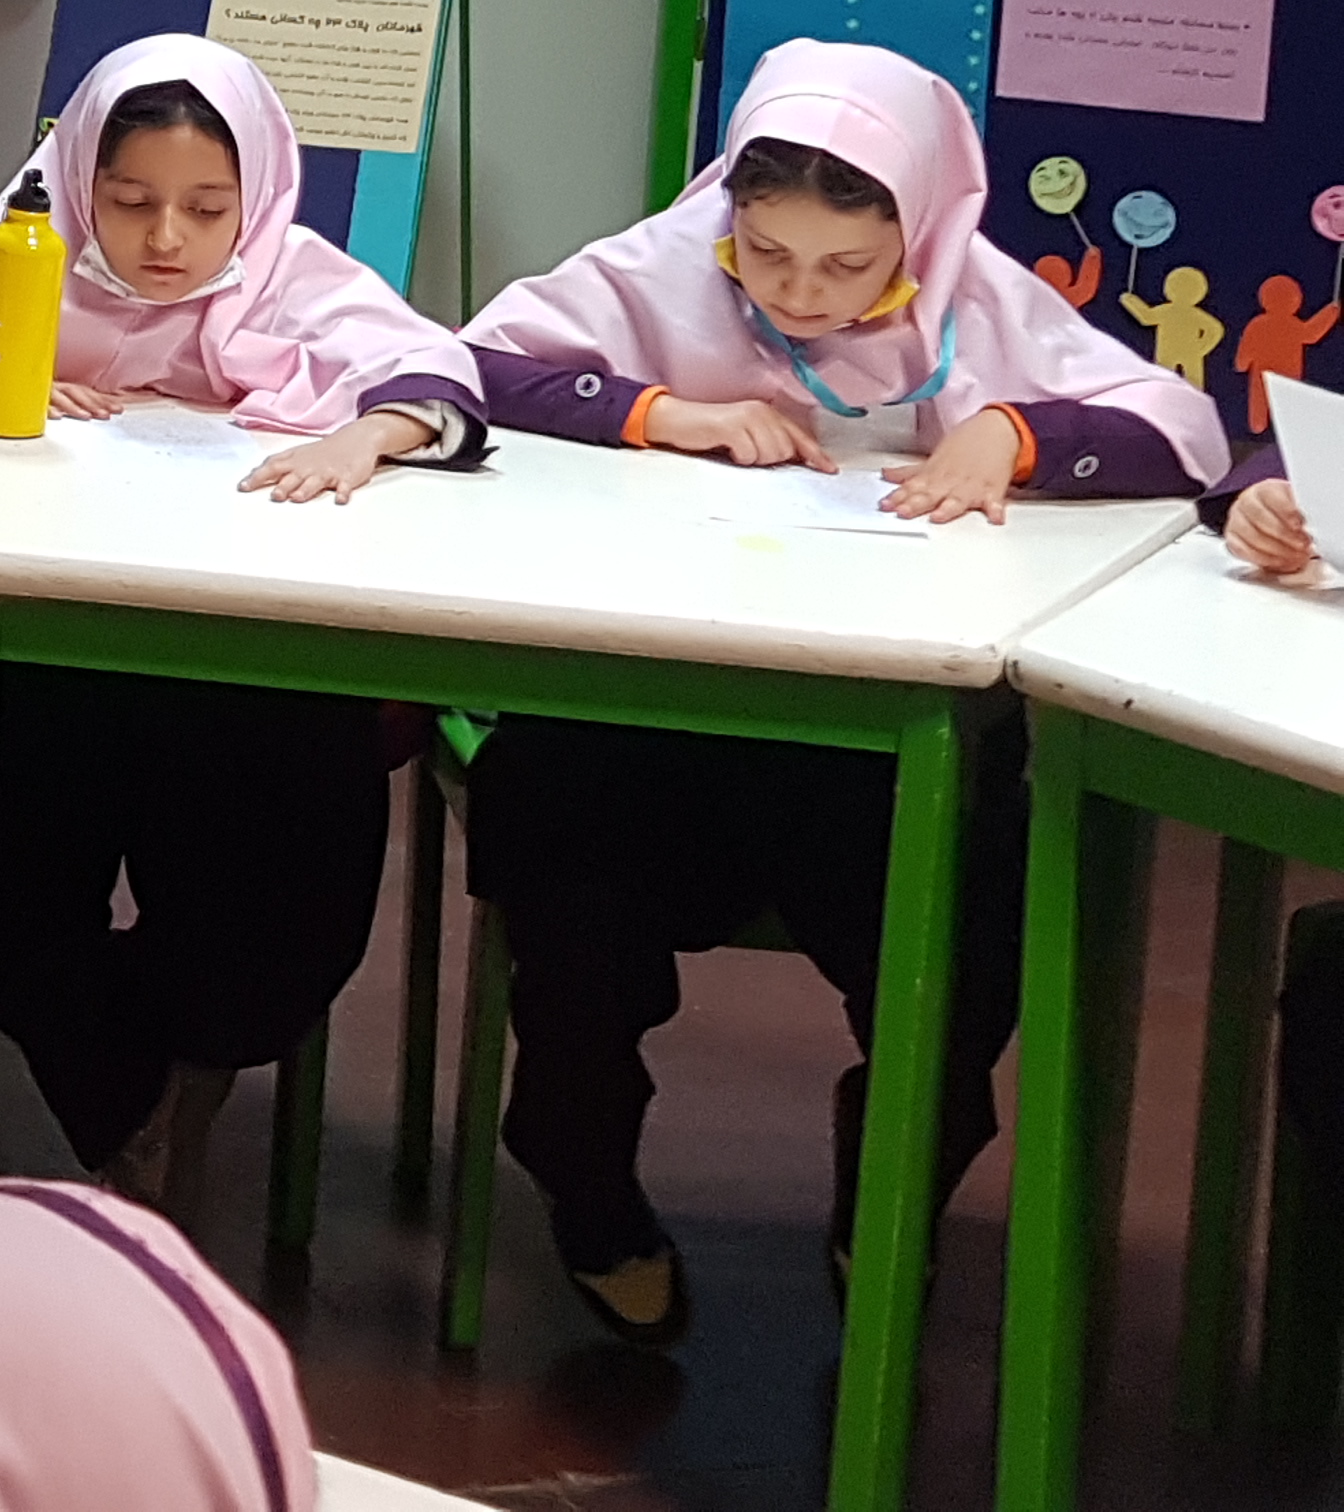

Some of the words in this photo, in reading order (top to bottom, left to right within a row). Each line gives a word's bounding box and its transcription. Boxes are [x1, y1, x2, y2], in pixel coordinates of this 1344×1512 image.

[233, 10, 267, 21] هستند
[270, 14, 306, 26] کسانی
[308, 16, 321, 29] چه
[345, 19, 369, 32] پلاک
[375, 20, 423, 34] قهرمانان
